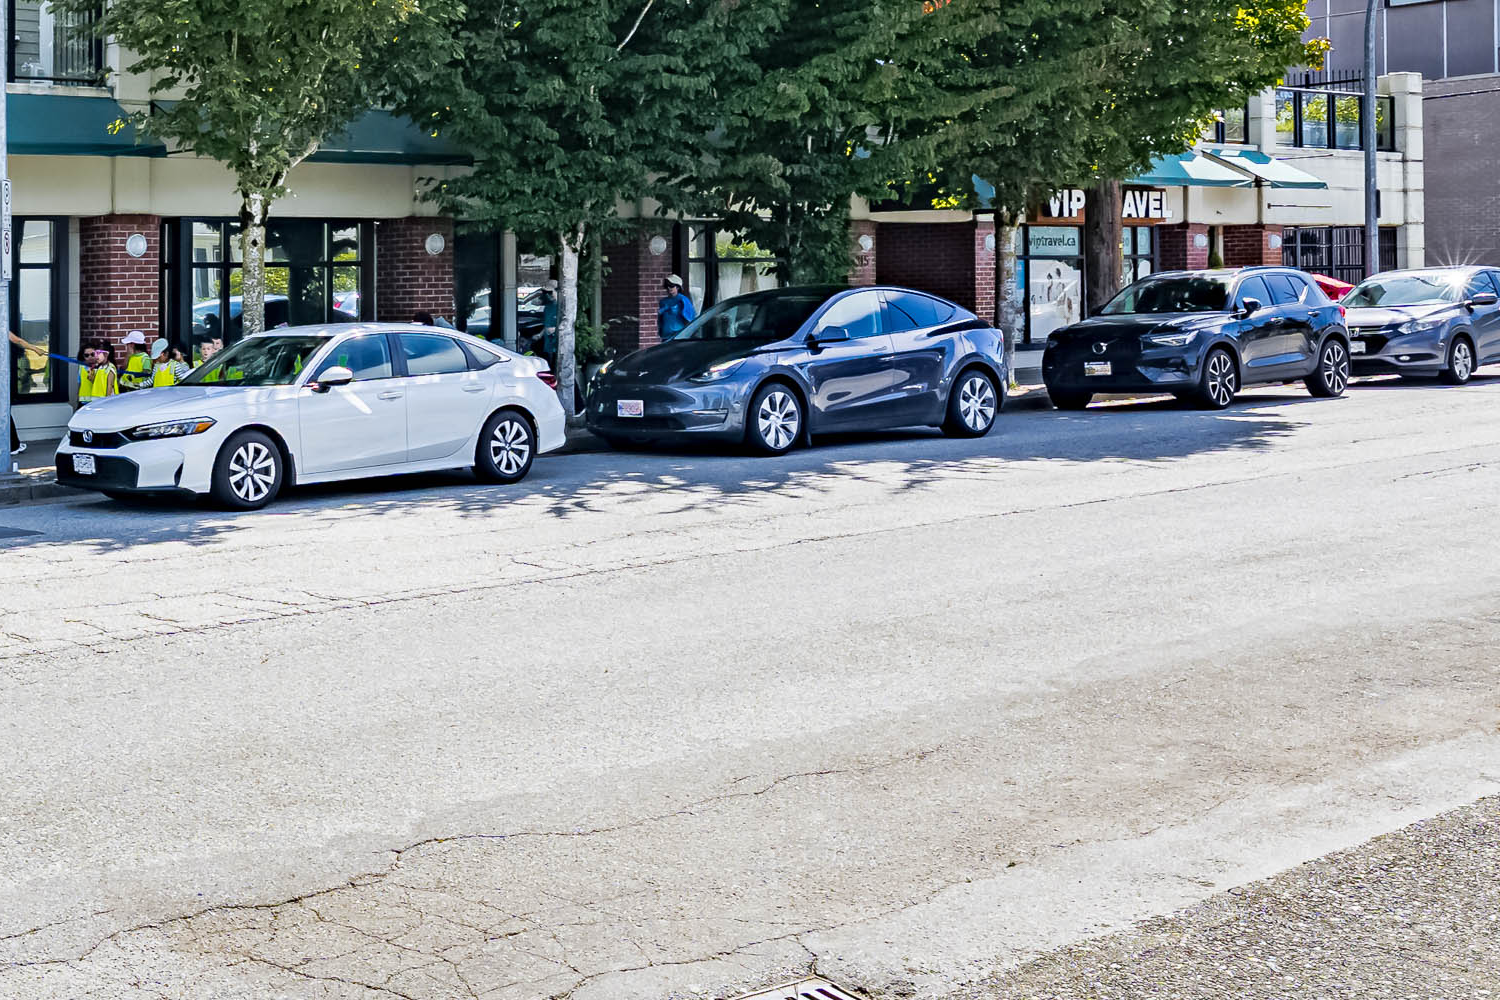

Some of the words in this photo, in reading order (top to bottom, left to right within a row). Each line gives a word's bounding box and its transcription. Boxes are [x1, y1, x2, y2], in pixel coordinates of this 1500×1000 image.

[1049, 188, 1086, 218] VIP
[1122, 190, 1173, 218] AVEL
[1029, 234, 1076, 249] viptravel.ca
